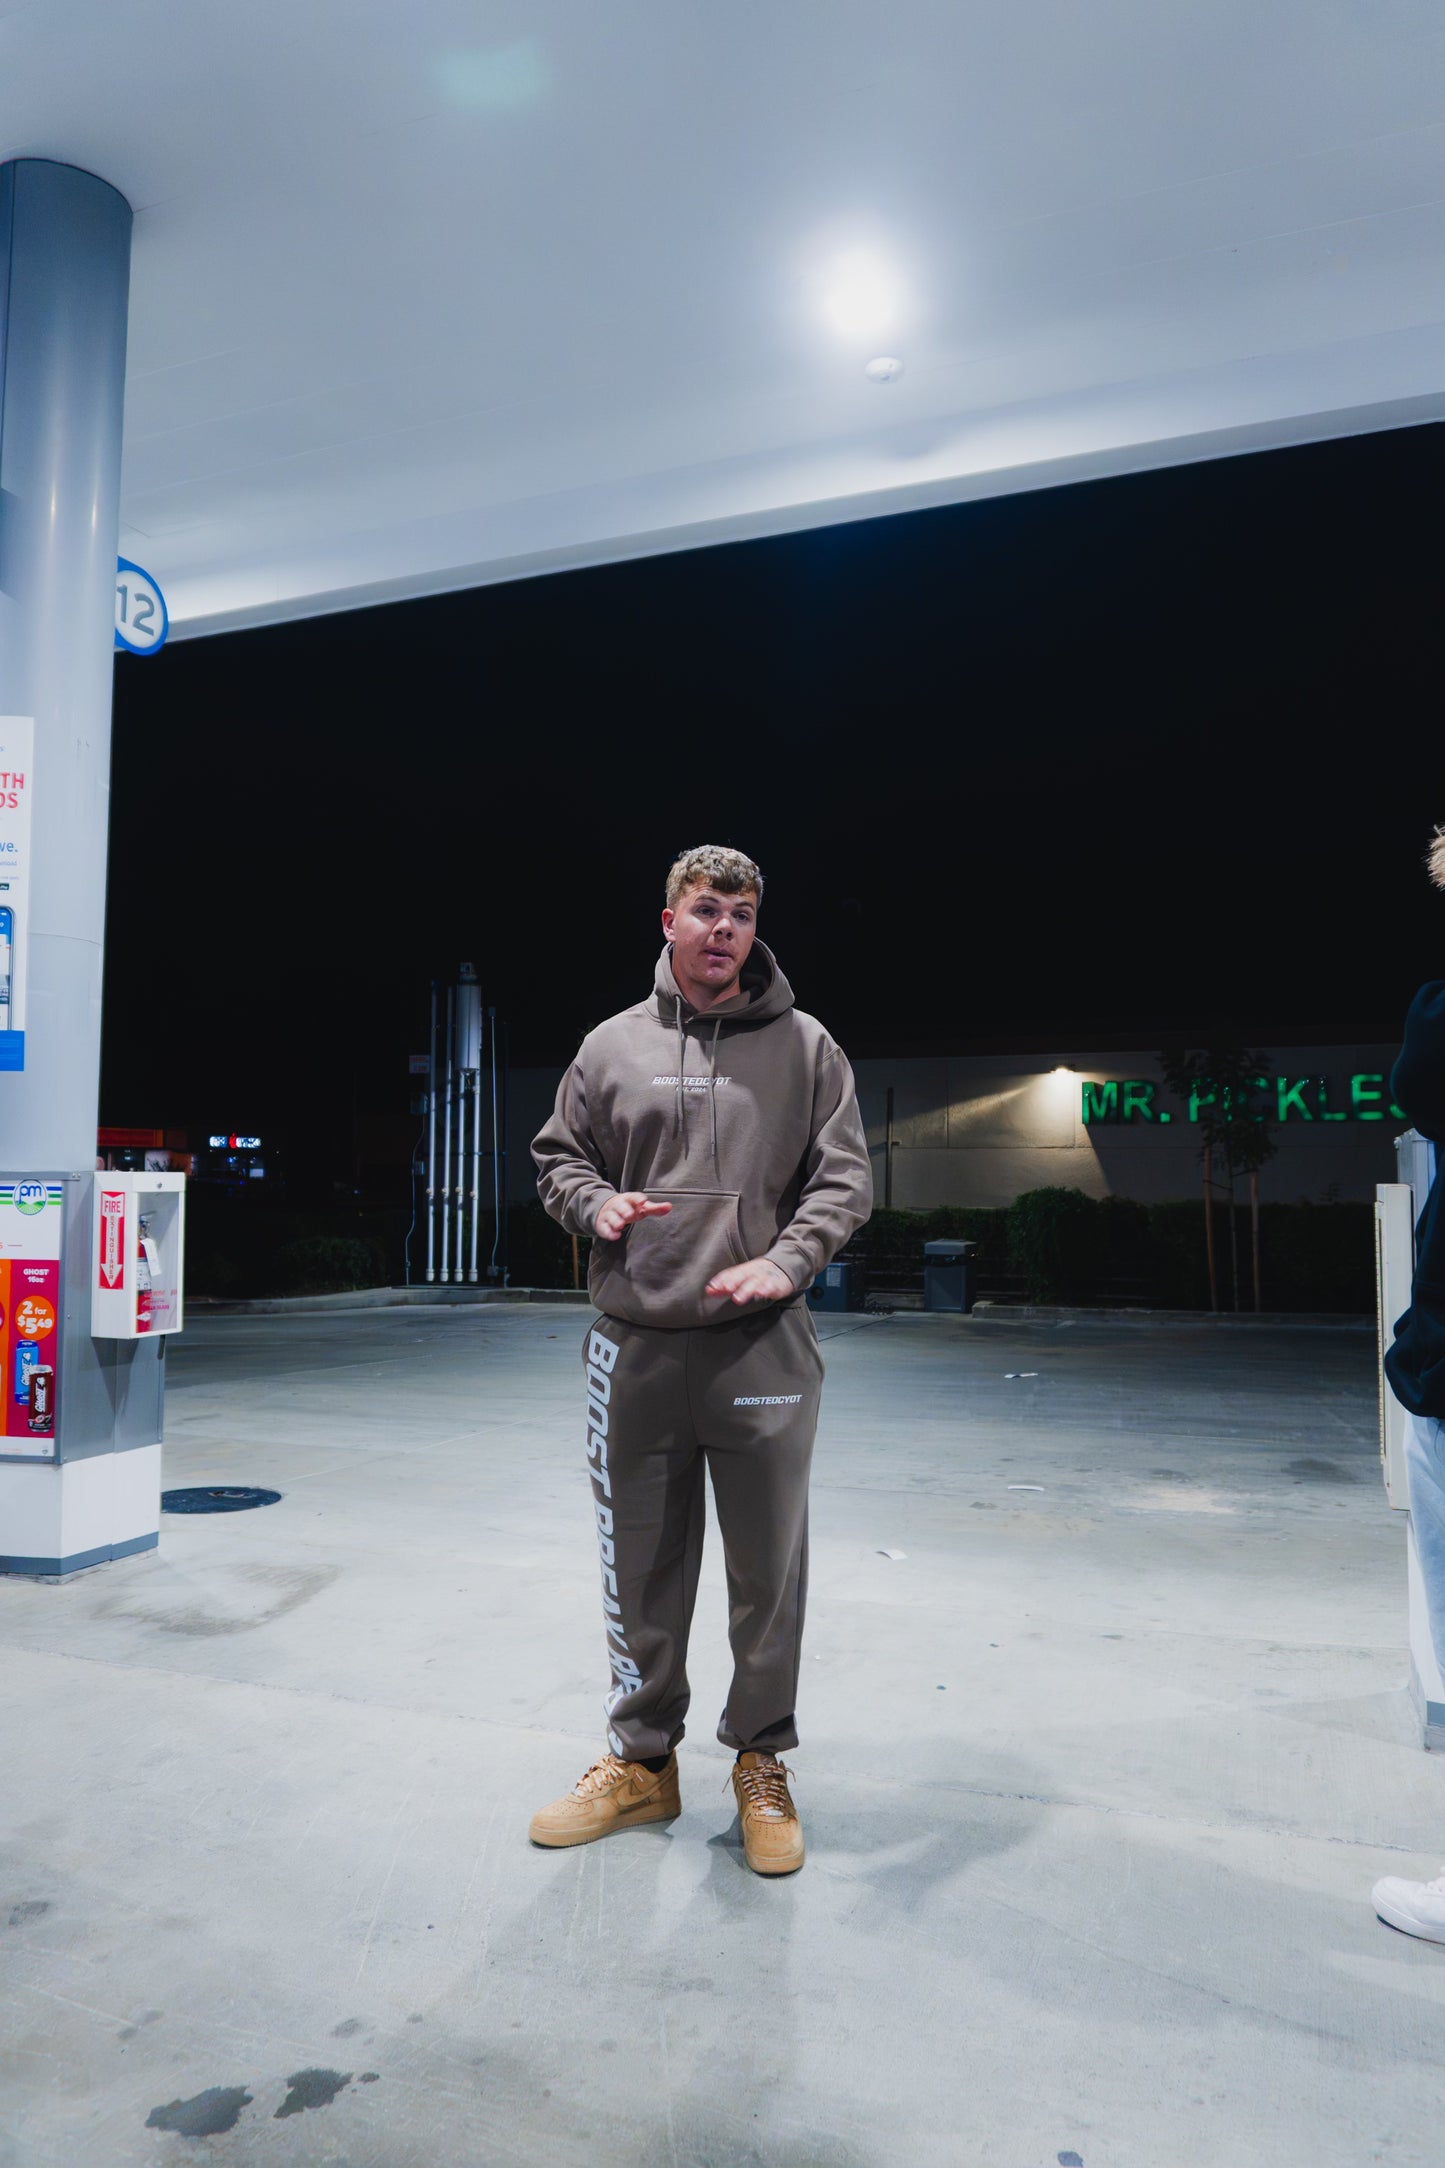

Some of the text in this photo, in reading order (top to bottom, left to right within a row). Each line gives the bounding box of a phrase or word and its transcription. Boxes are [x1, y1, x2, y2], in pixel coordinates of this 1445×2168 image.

[117, 584, 155, 637] 12
[1081, 1080, 1171, 1124] MR.
[104, 1201, 121, 1213] FIRE
[23, 1268, 50, 1276] GHOST
[22, 1301, 47, 1315] 2 for
[586, 1330, 620, 1499] BOOST
